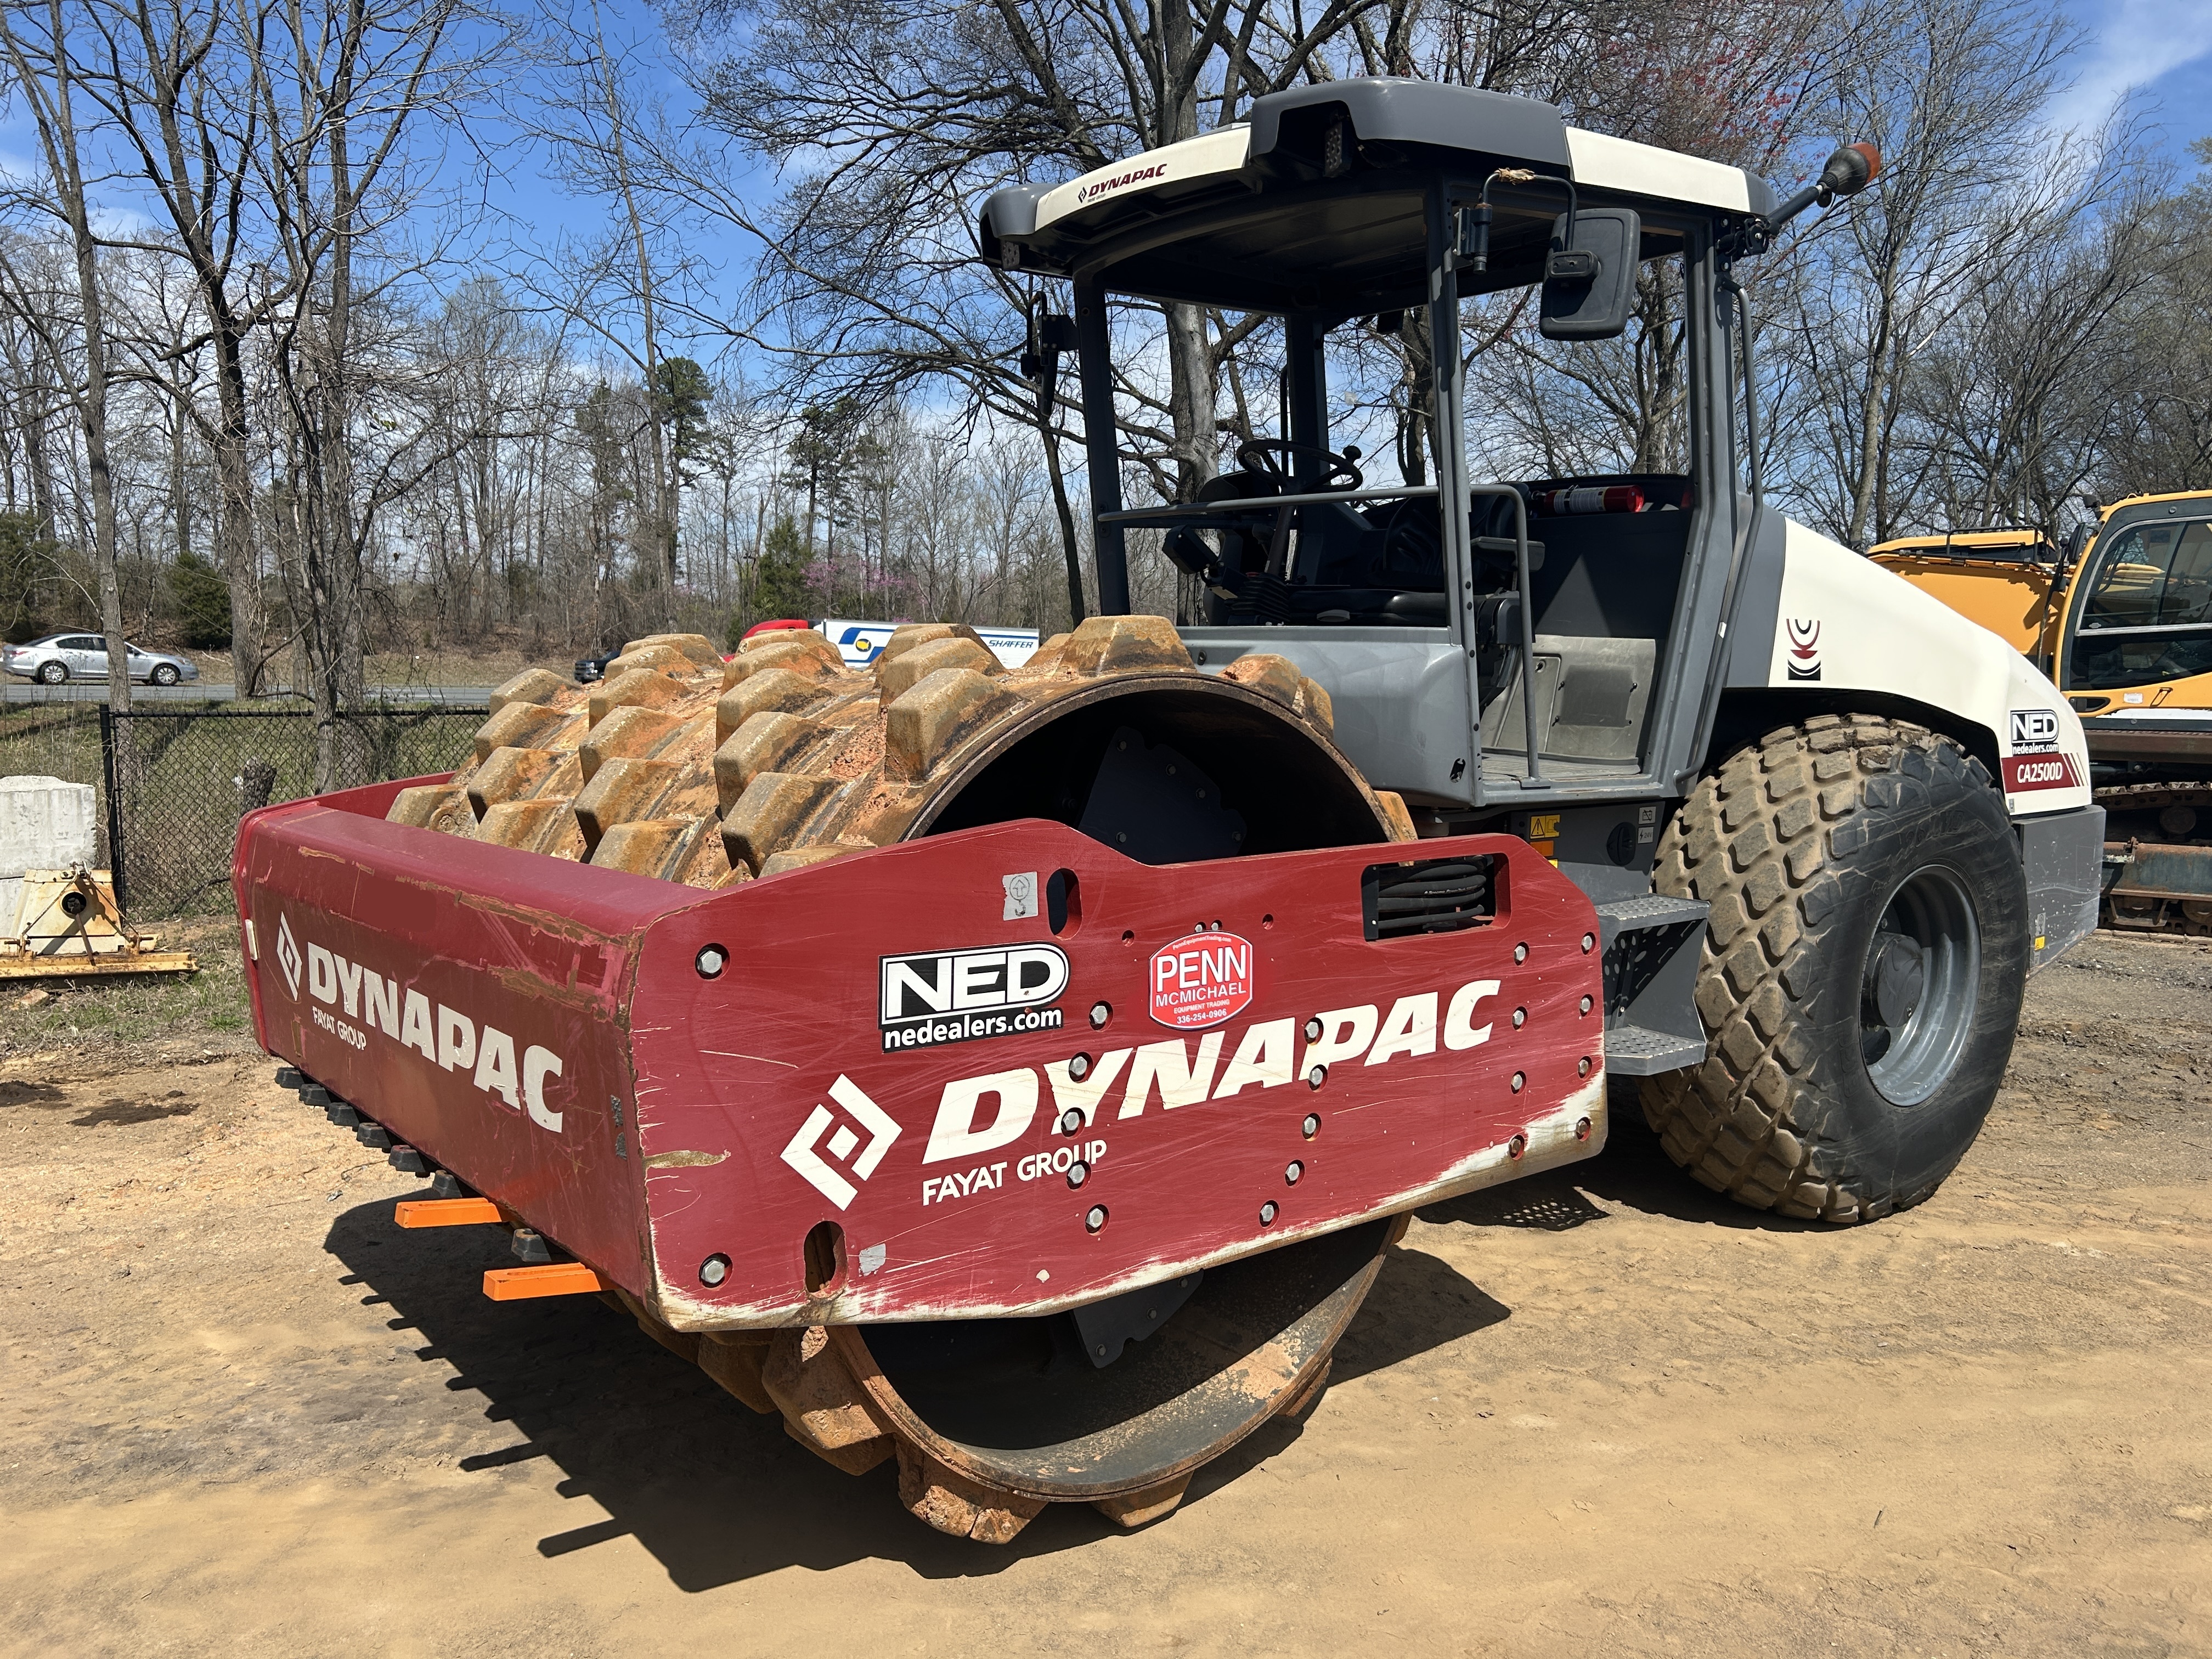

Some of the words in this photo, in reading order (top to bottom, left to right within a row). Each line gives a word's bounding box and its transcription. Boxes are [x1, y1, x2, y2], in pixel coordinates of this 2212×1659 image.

[1088, 163, 1167, 198] DYNAPAC
[988, 639, 1034, 648] SHAFFER
[2012, 713, 2058, 741] NED
[2013, 743, 2058, 755] nedealers.com
[2017, 761, 2063, 783] CA2500D
[885, 950, 1066, 1018] NED
[1156, 944, 1246, 992] PENN
[1156, 981, 1246, 1008] MCMICHAEL
[1173, 1002, 1205, 1014] EQUIPMENT
[1206, 998, 1230, 1009] TRADING
[312, 1006, 336, 1034] FAYAT
[337, 1019, 367, 1051] GROUP
[884, 1008, 1062, 1049] nedealers.com
[1176, 1008, 1227, 1024] 336-254-0906
[307, 941, 563, 1133] DYNAPAC
[922, 980, 1500, 1165] DYNAPAC
[923, 1161, 1008, 1206] FAYAT
[1017, 1139, 1107, 1183] GROUP
